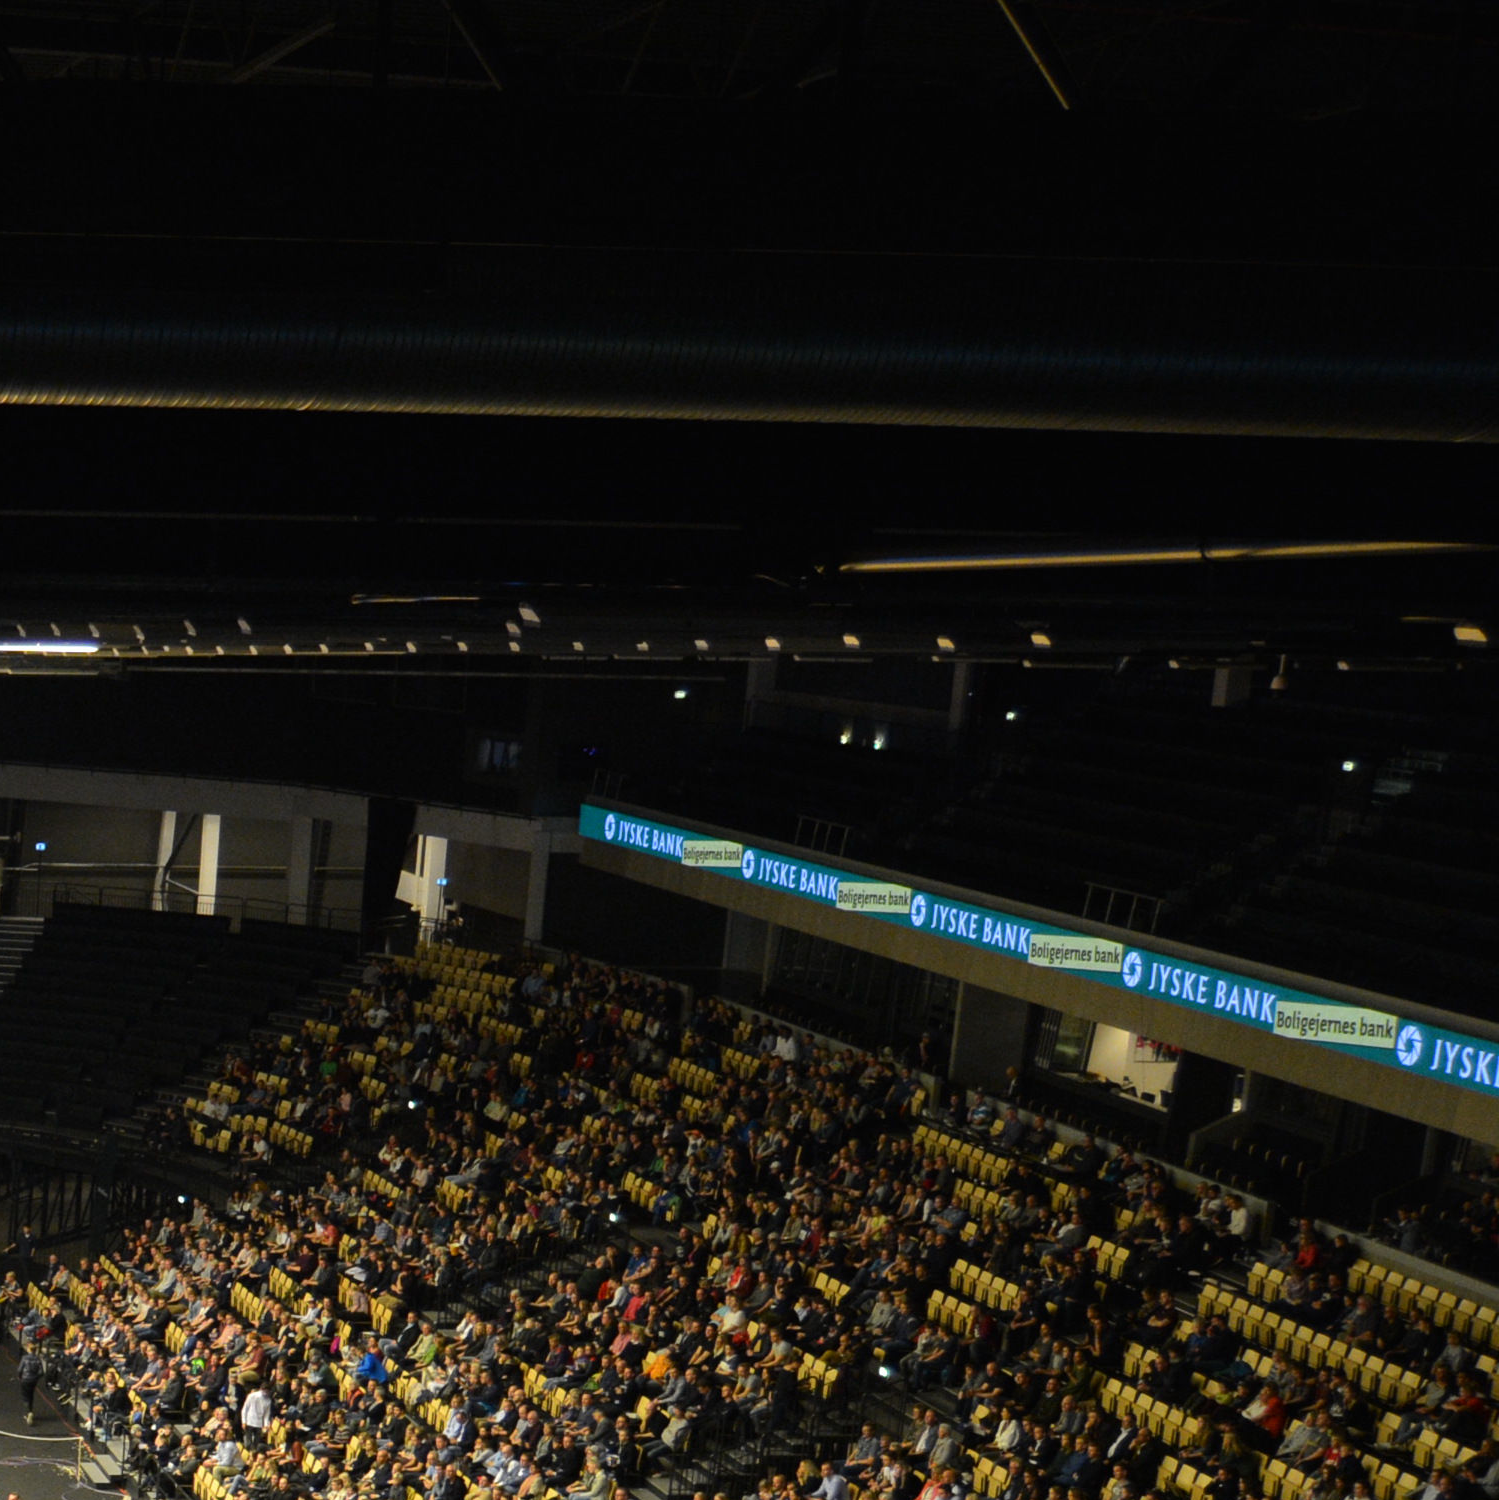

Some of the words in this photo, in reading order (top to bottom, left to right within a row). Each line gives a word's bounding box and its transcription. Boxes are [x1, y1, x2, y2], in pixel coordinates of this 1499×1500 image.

[617, 820, 650, 848] JYSKE
[652, 829, 683, 857] BANK
[723, 847, 741, 861] bank
[758, 857, 796, 889] JYSKE
[800, 868, 839, 901] BANK
[838, 889, 887, 909] Boligejernes
[888, 889, 910, 907] bank
[931, 904, 978, 940] JYSKE
[982, 917, 1030, 955] BANK
[1030, 942, 1093, 965] Boligejernes
[1094, 943, 1121, 965] bank
[1148, 963, 1209, 1005] JYSKE
[1214, 980, 1277, 1024] BANK
[1276, 1011, 1356, 1037] Boligejernes
[1360, 1017, 1394, 1040] bank
